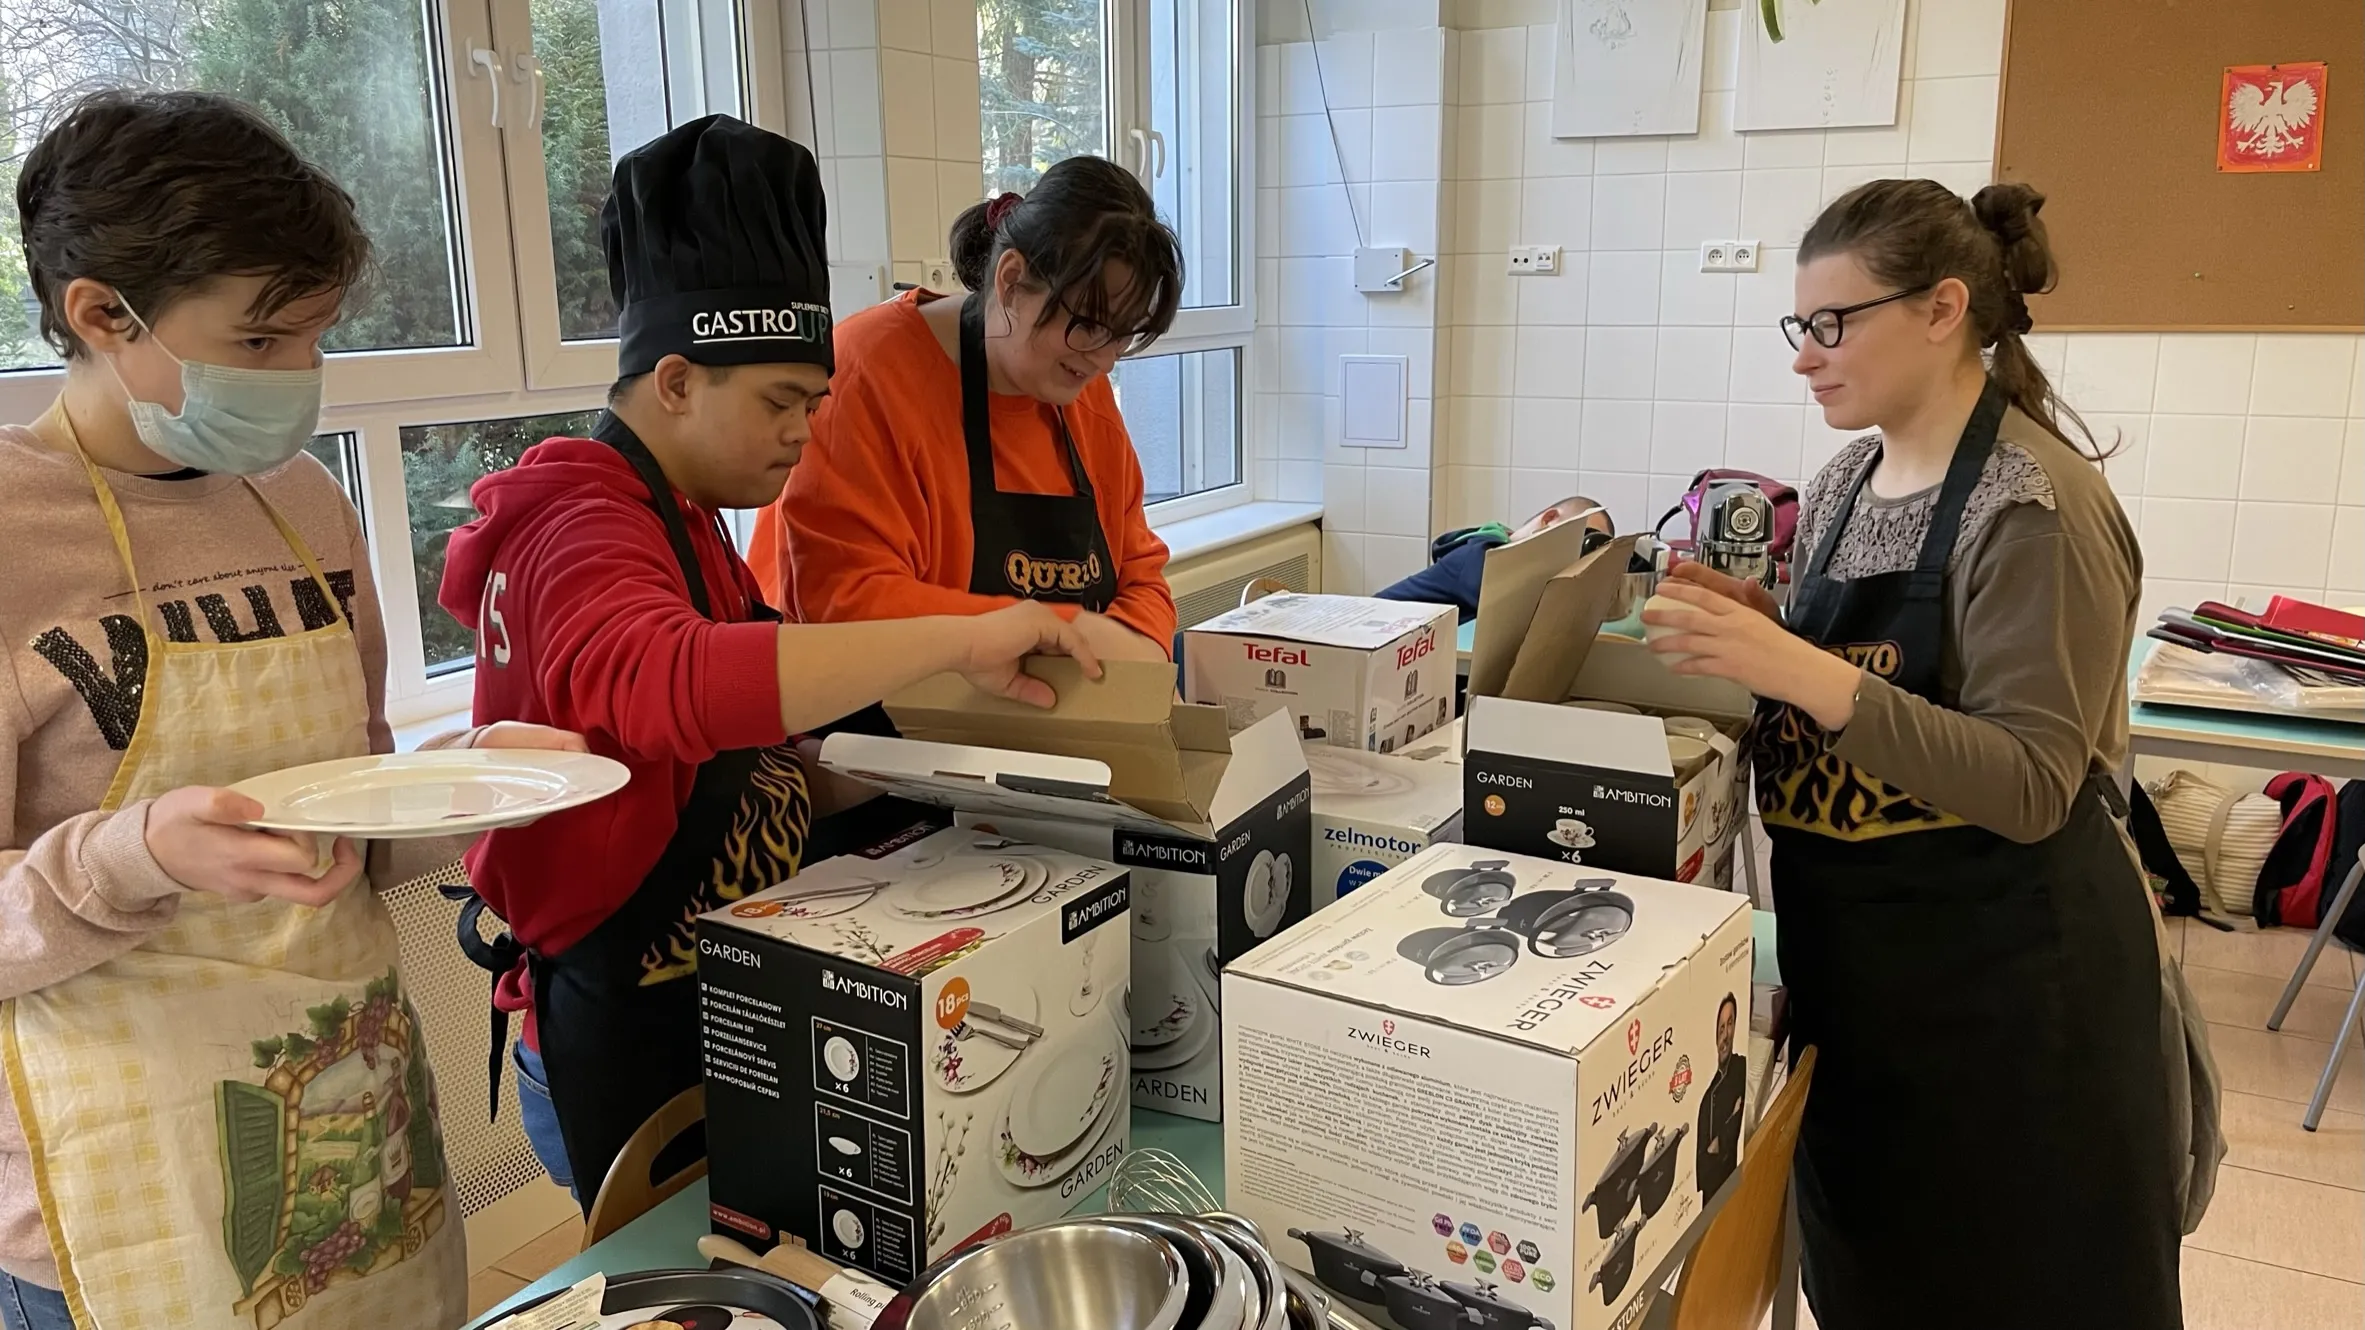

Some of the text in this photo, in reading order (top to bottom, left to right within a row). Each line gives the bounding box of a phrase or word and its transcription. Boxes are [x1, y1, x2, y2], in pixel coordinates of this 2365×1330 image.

[153, 579, 184, 592] don't
[187, 575, 210, 586] care
[213, 569, 243, 582] about
[246, 566, 279, 577] anyone
[1243, 643, 1312, 667] Tefal
[1396, 630, 1436, 671] Tefal
[1476, 771, 1533, 789] GARDEN
[1282, 787, 1310, 815] AMBITION
[1558, 806, 1585, 816] 250 ml
[1605, 788, 1672, 808] AMBITION
[1136, 844, 1206, 864] AMBITION
[1220, 830, 1250, 862] GARDEN
[1324, 827, 1422, 854] zelmotor
[1031, 865, 1106, 904] GARDEN
[1349, 866, 1372, 878] Dwie
[1078, 887, 1126, 925] AMBITION
[700, 938, 760, 969] GARDEN
[709, 985, 782, 1014] KOMPLET PORCELANOWY
[836, 976, 907, 1011] AMBITION
[938, 993, 956, 1018] 18
[1506, 960, 1614, 1030] ZWIEGER
[710, 1014, 754, 1034] PORCELAIN SET
[1348, 1026, 1430, 1058] ZWIEGER
[712, 1057, 739, 1071] SERVICIU
[740, 1066, 748, 1074] DE
[756, 1057, 776, 1070] SERVIS
[1592, 1026, 1673, 1126] ZWIEGER
[1130, 1077, 1207, 1104] ARDEN
[1060, 1138, 1124, 1200] GARDEN
[850, 1288, 876, 1306] Rolling
[1616, 1290, 1645, 1330] STONE
